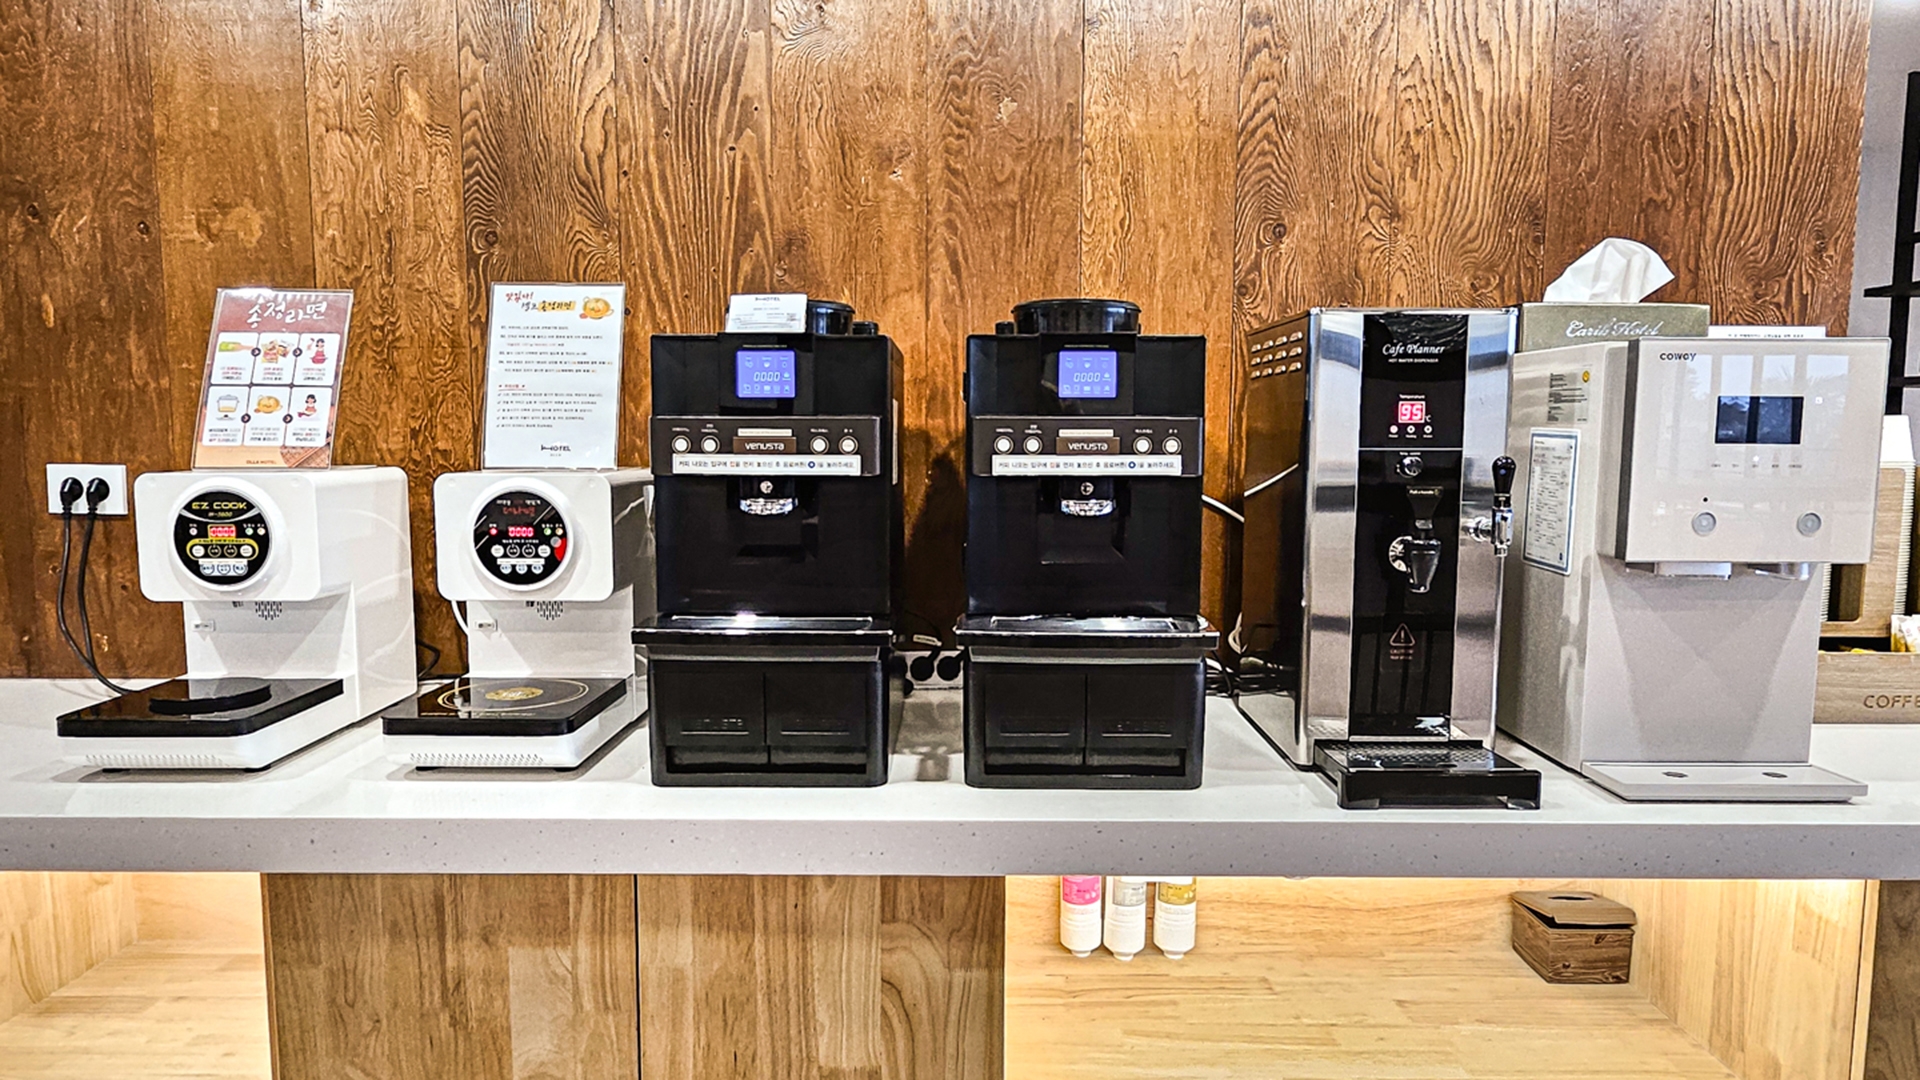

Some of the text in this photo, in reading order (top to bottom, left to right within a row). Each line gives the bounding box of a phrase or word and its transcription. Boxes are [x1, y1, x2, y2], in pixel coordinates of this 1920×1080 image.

[246, 298, 328, 329] 송정라면
[1612, 321, 1665, 337] Hotel
[1382, 342, 1446, 357] Cafe Planner
[1659, 351, 1697, 362] coway
[754, 371, 781, 382] 0000
[1073, 372, 1101, 382] 0000
[1401, 403, 1423, 421] 95
[191, 501, 247, 510] EZ COOK
[508, 527, 534, 538] 0000
